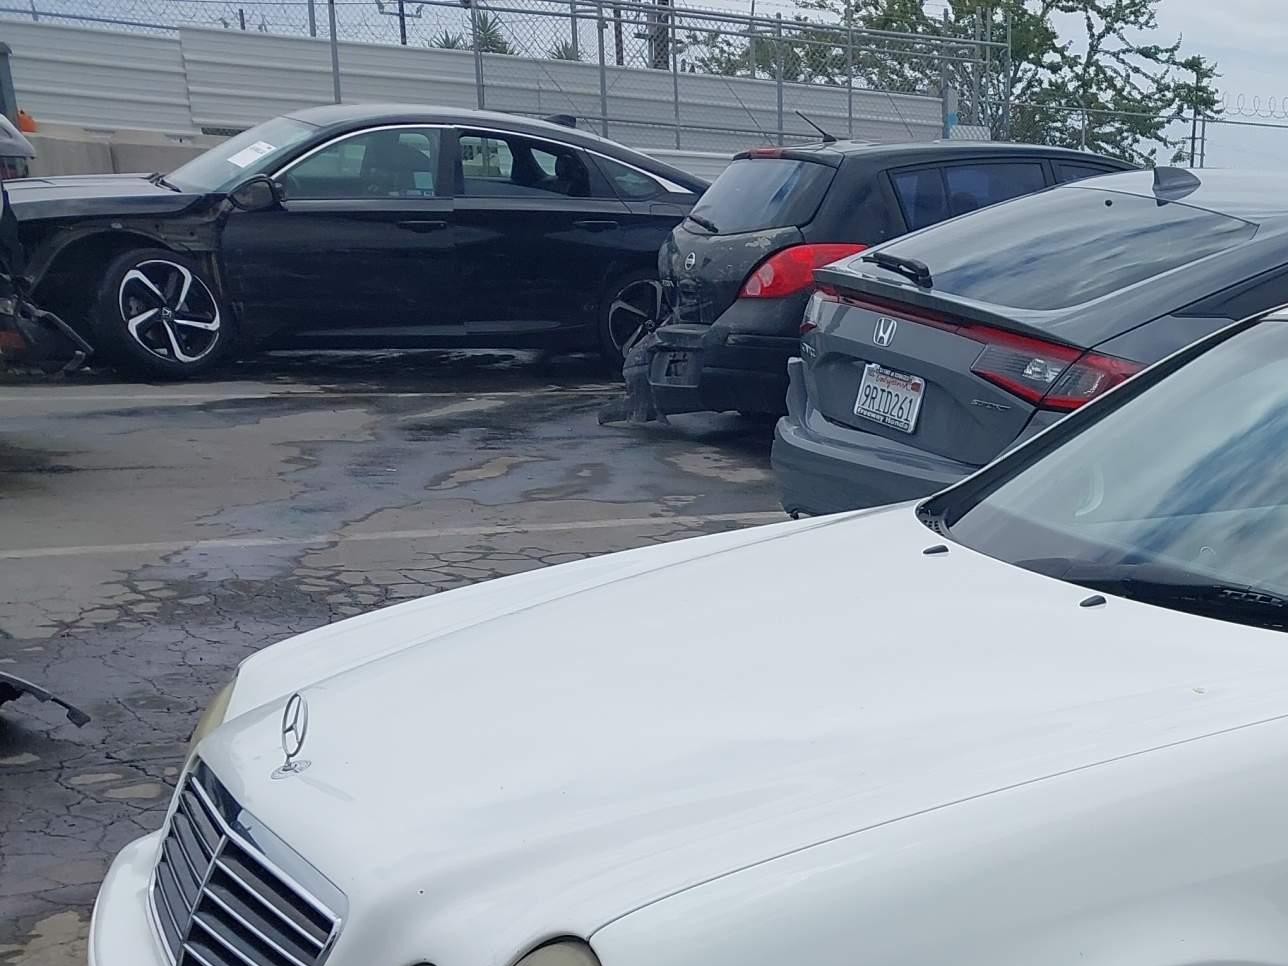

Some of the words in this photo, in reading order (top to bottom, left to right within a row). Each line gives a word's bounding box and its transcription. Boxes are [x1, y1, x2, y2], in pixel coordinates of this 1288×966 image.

[856, 407, 885, 423] Freeway
[885, 416, 910, 429] Honda
[861, 384, 914, 422] 9RID261
